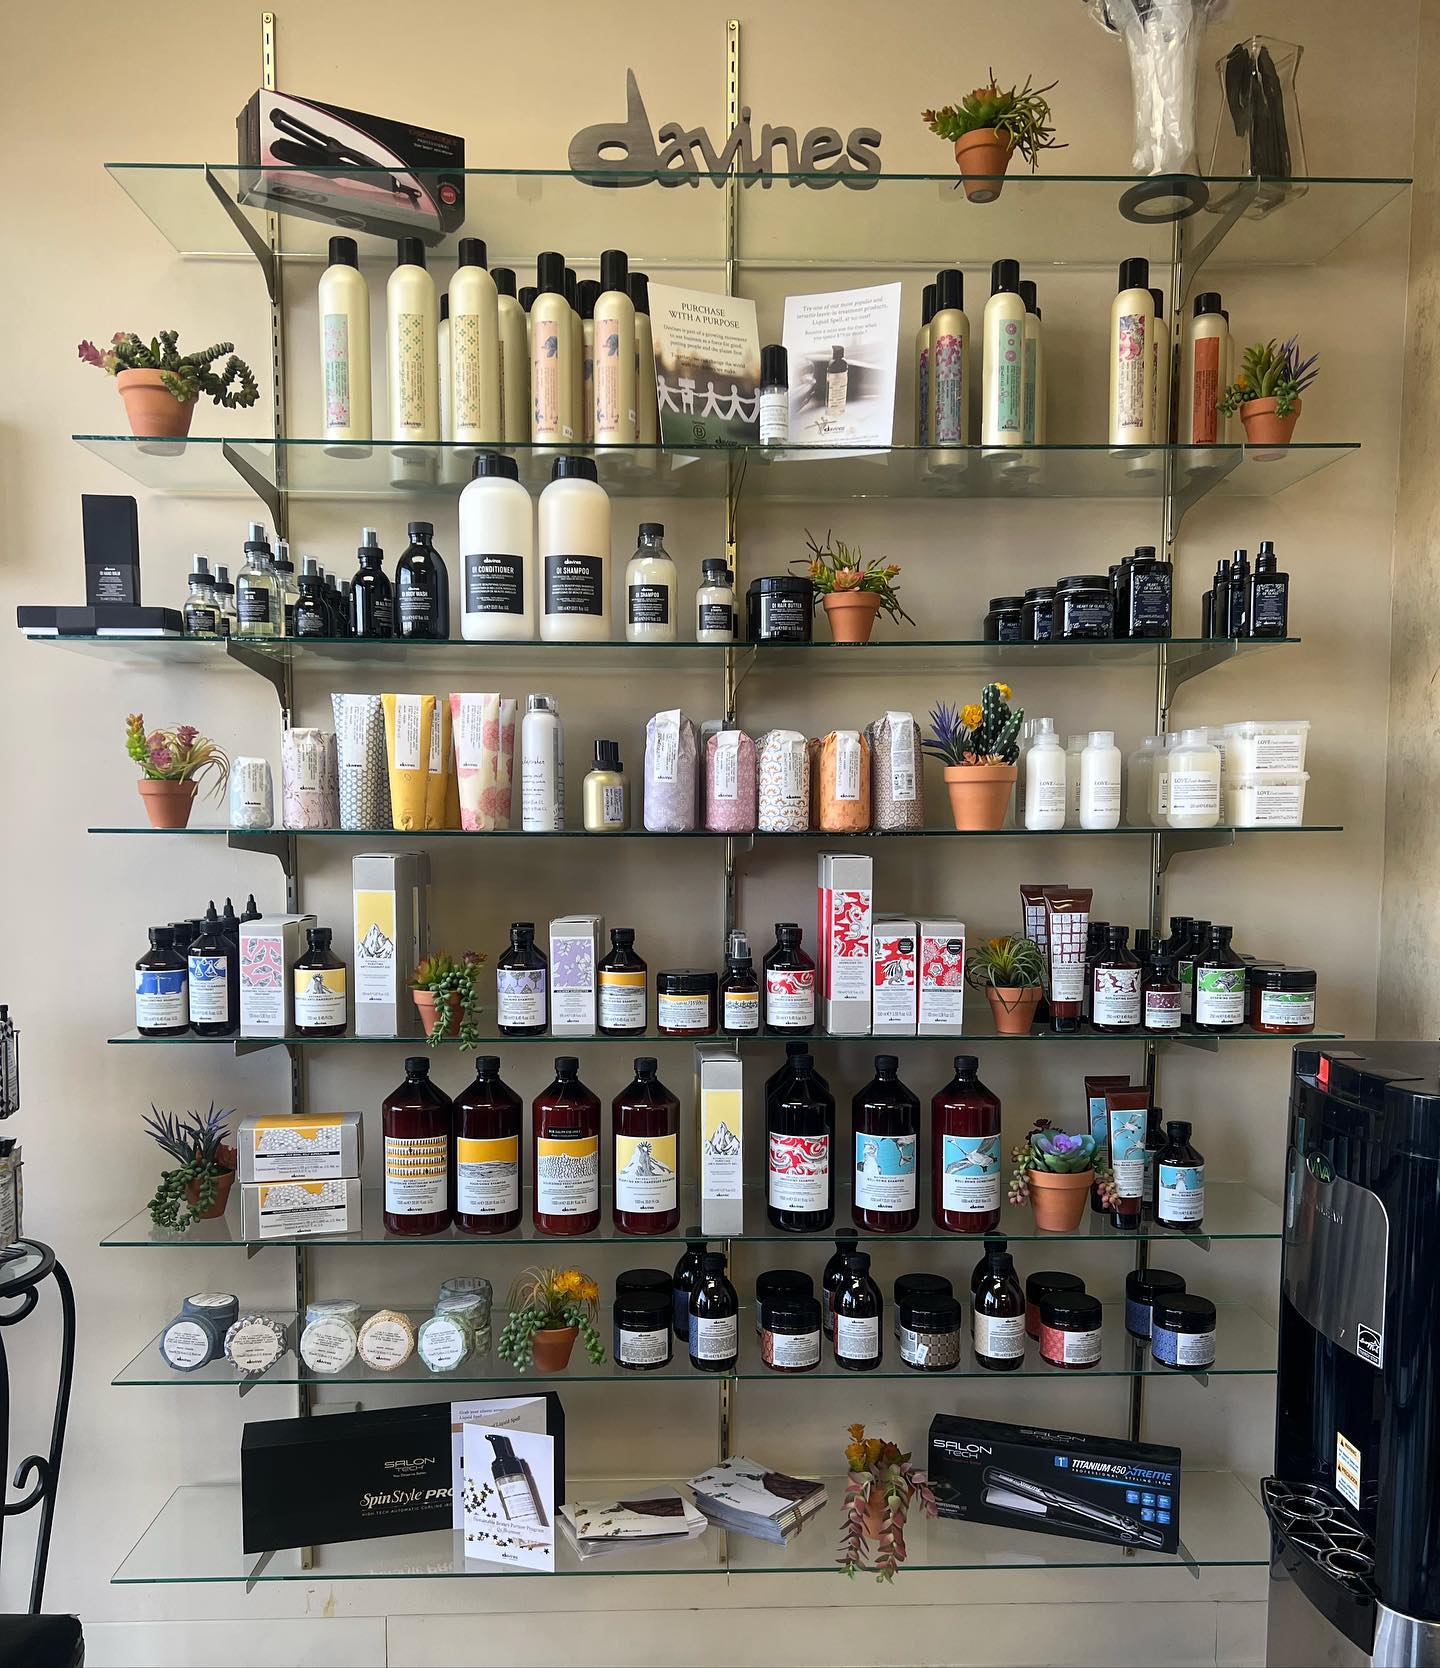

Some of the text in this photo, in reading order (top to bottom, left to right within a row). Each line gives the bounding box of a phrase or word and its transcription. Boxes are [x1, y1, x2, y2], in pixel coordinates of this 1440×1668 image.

[569, 68, 882, 190] davines
[681, 302, 726, 317] PURCHASE
[668, 309, 740, 329] WITH A PURPOSE
[478, 566, 515, 574] CONDITIONER
[563, 567, 590, 575] SHAMPOO
[933, 1439, 993, 1455] SALON
[944, 1449, 979, 1460] TECH
[384, 1457, 435, 1469] SALON
[1072, 1459, 1111, 1473] TITANIUM
[1111, 1466, 1126, 1475] 450
[1072, 1468, 1119, 1479] PROFESSIONAL
